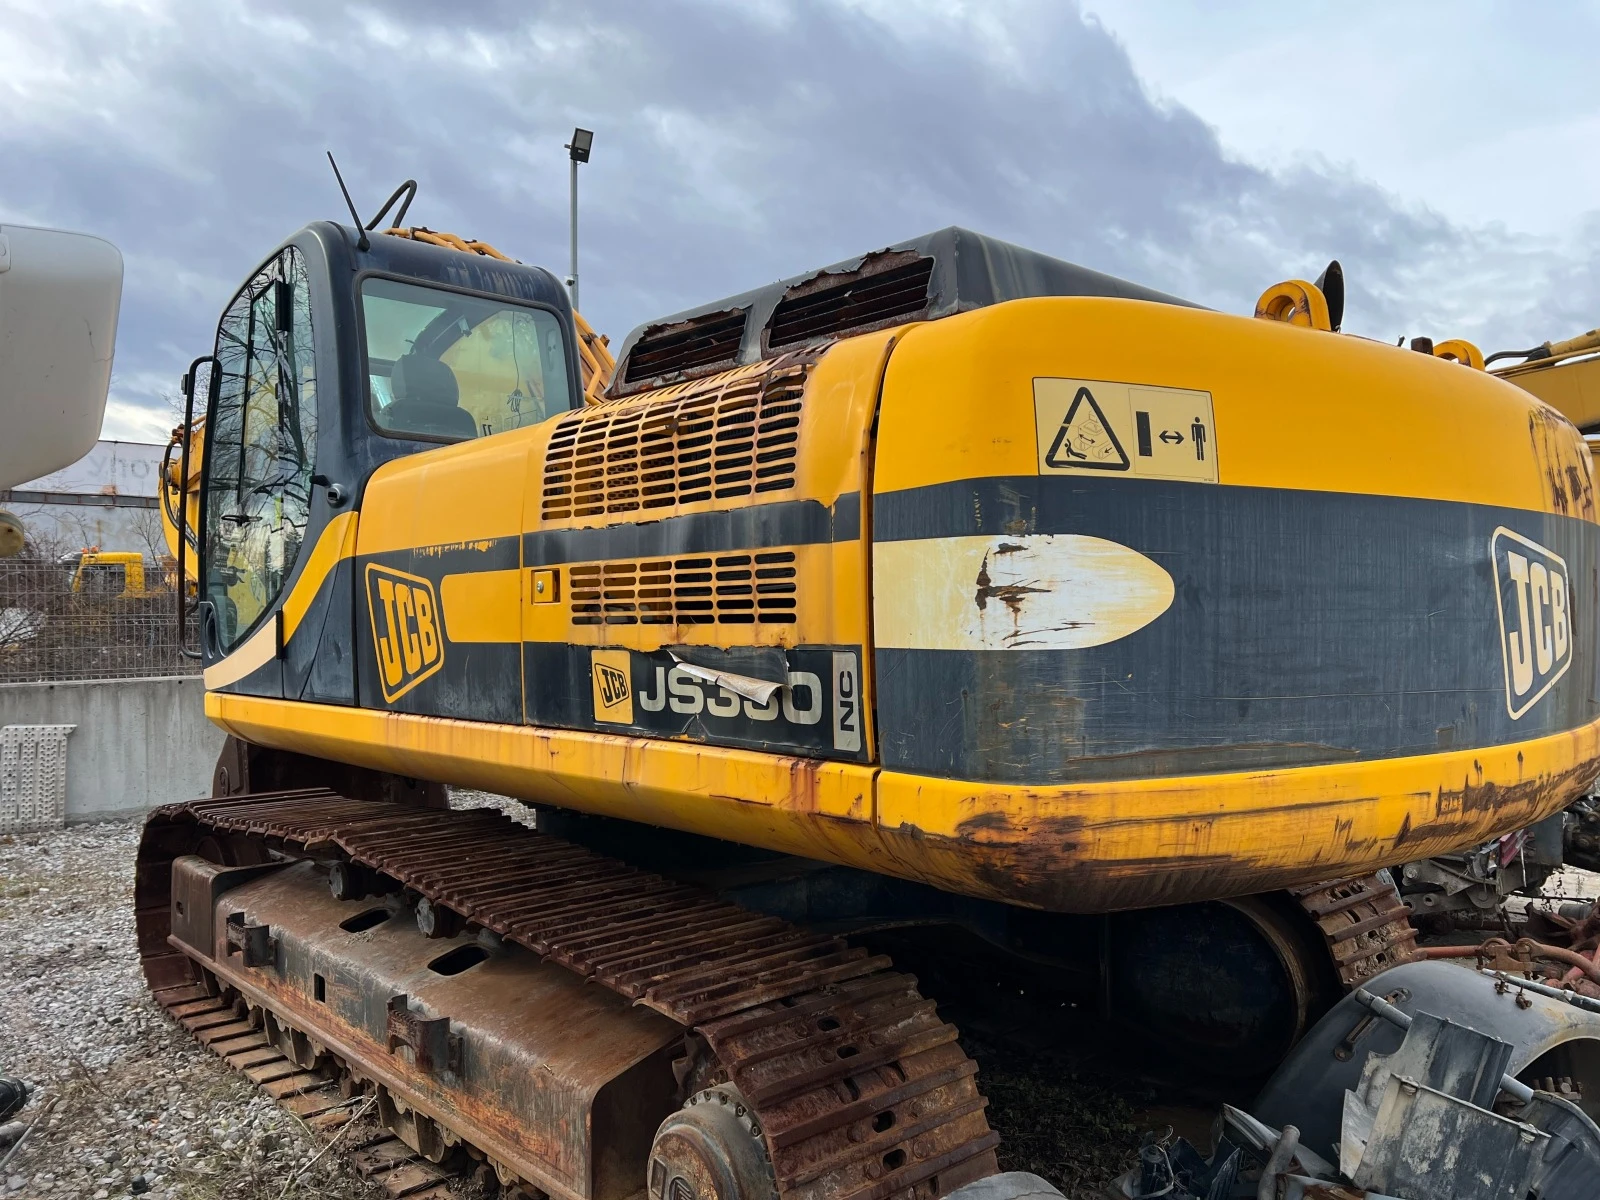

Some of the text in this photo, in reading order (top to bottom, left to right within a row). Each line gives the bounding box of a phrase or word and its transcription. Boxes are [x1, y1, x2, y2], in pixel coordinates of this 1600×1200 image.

[378, 578, 437, 686] JCB
[1508, 551, 1567, 696] JCB
[601, 668, 626, 703] JCB
[840, 670, 854, 732] NC
